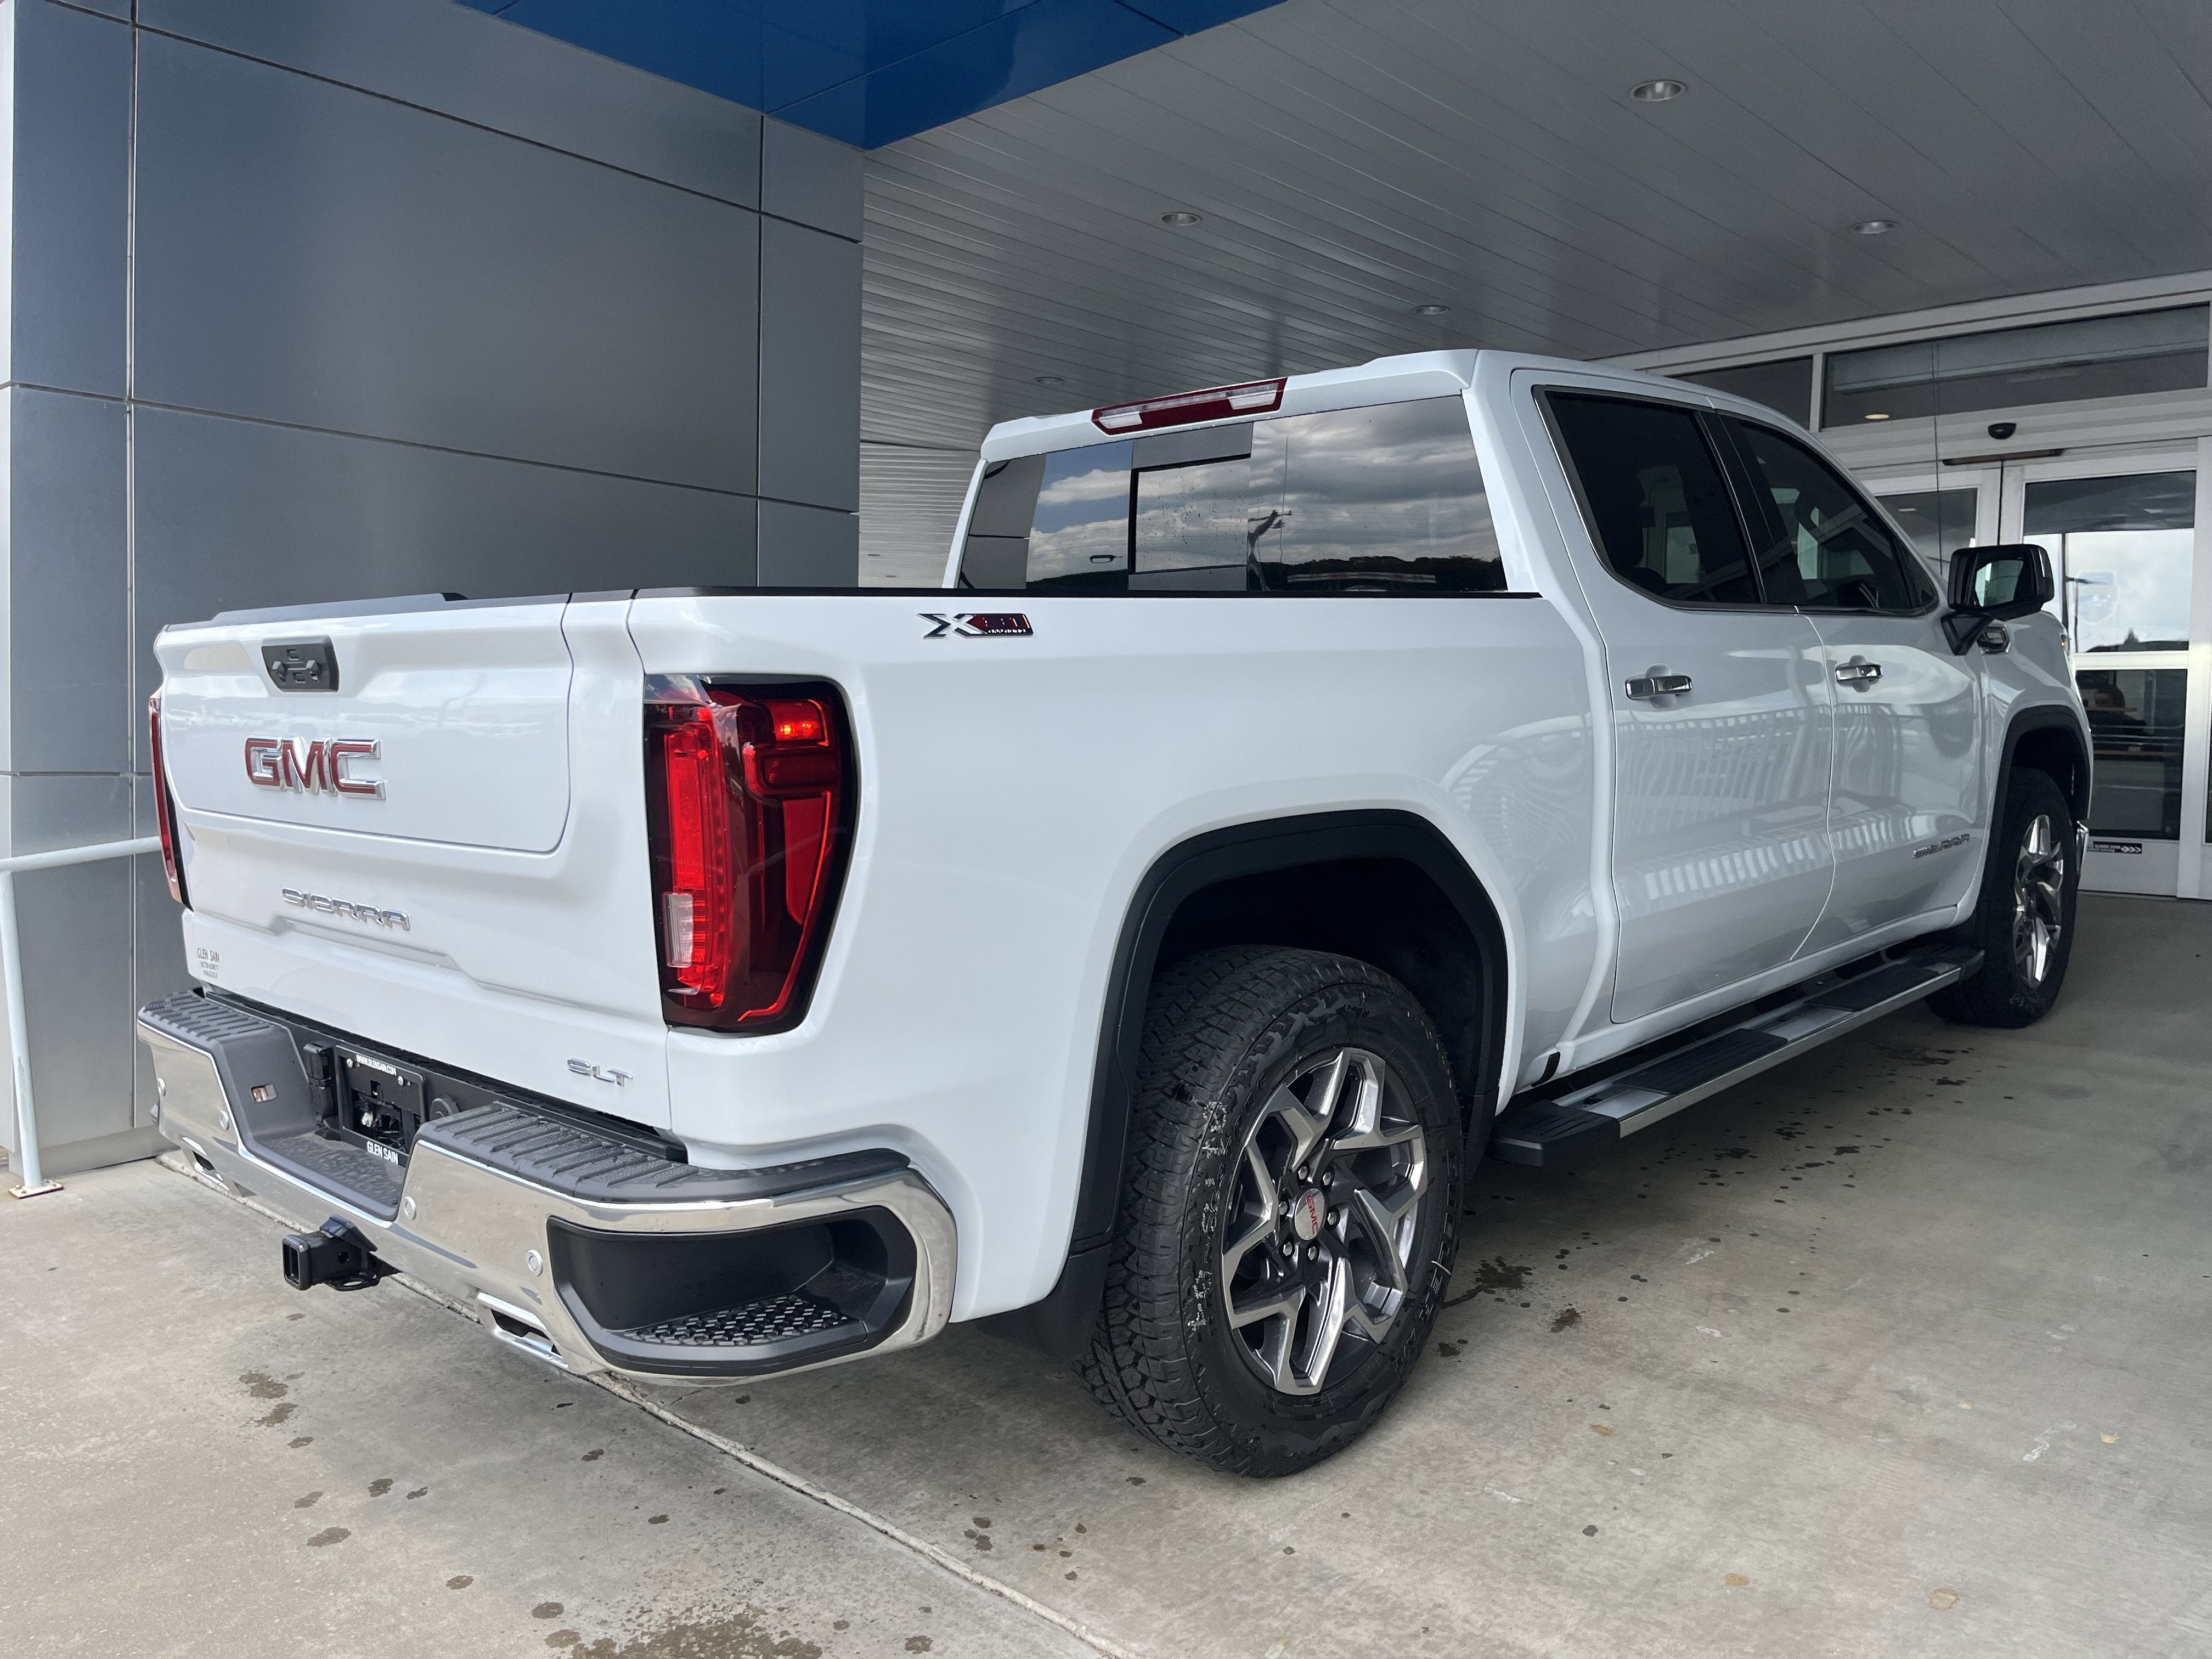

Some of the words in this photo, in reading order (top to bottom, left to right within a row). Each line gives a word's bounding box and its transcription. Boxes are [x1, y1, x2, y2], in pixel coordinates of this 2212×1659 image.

[245, 735, 386, 800] GMC
[282, 887, 410, 931] SIERRA
[197, 947, 208, 960] GLEN
[567, 1058, 633, 1087] SLT
[366, 1141, 383, 1158] GLEN
[383, 1147, 398, 1165] SAIN
[1306, 1194, 1318, 1235] GMC
